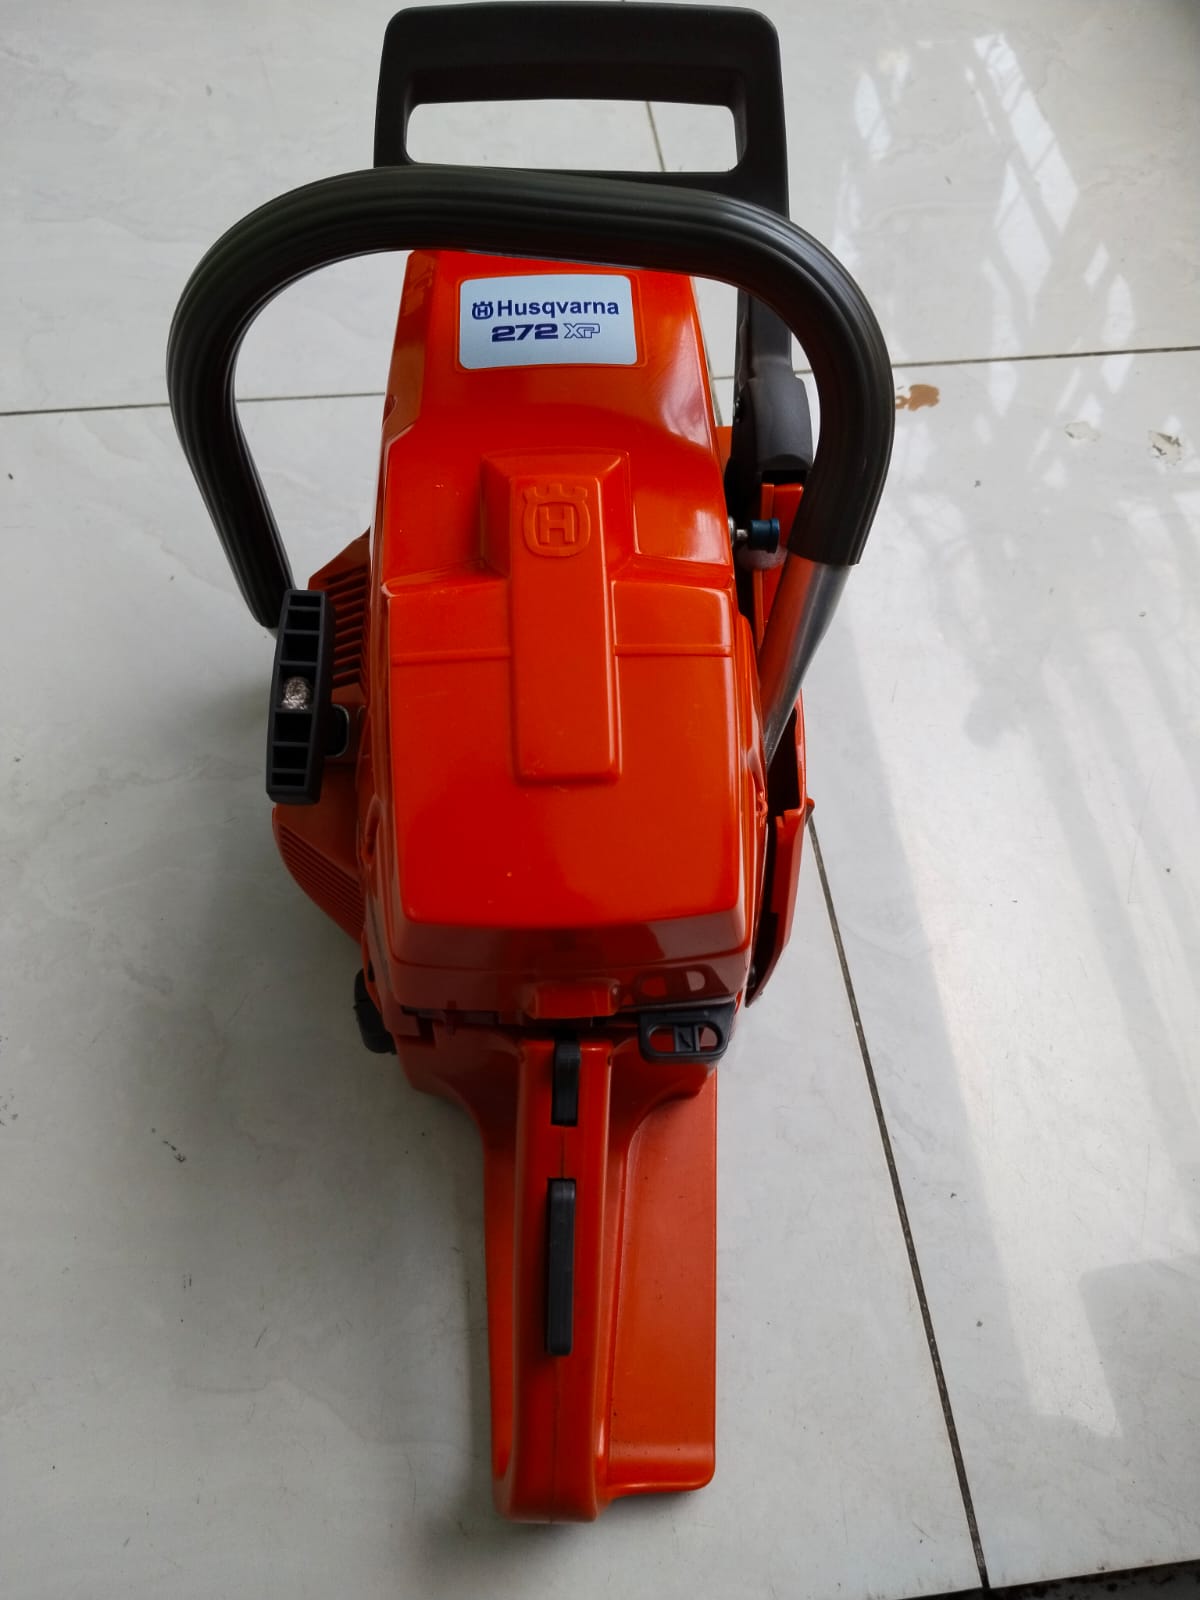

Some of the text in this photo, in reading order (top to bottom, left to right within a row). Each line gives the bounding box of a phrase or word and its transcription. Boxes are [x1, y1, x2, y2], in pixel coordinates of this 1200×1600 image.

[497, 300, 620, 318] Husqvarna
[491, 323, 601, 342] 272 XP
